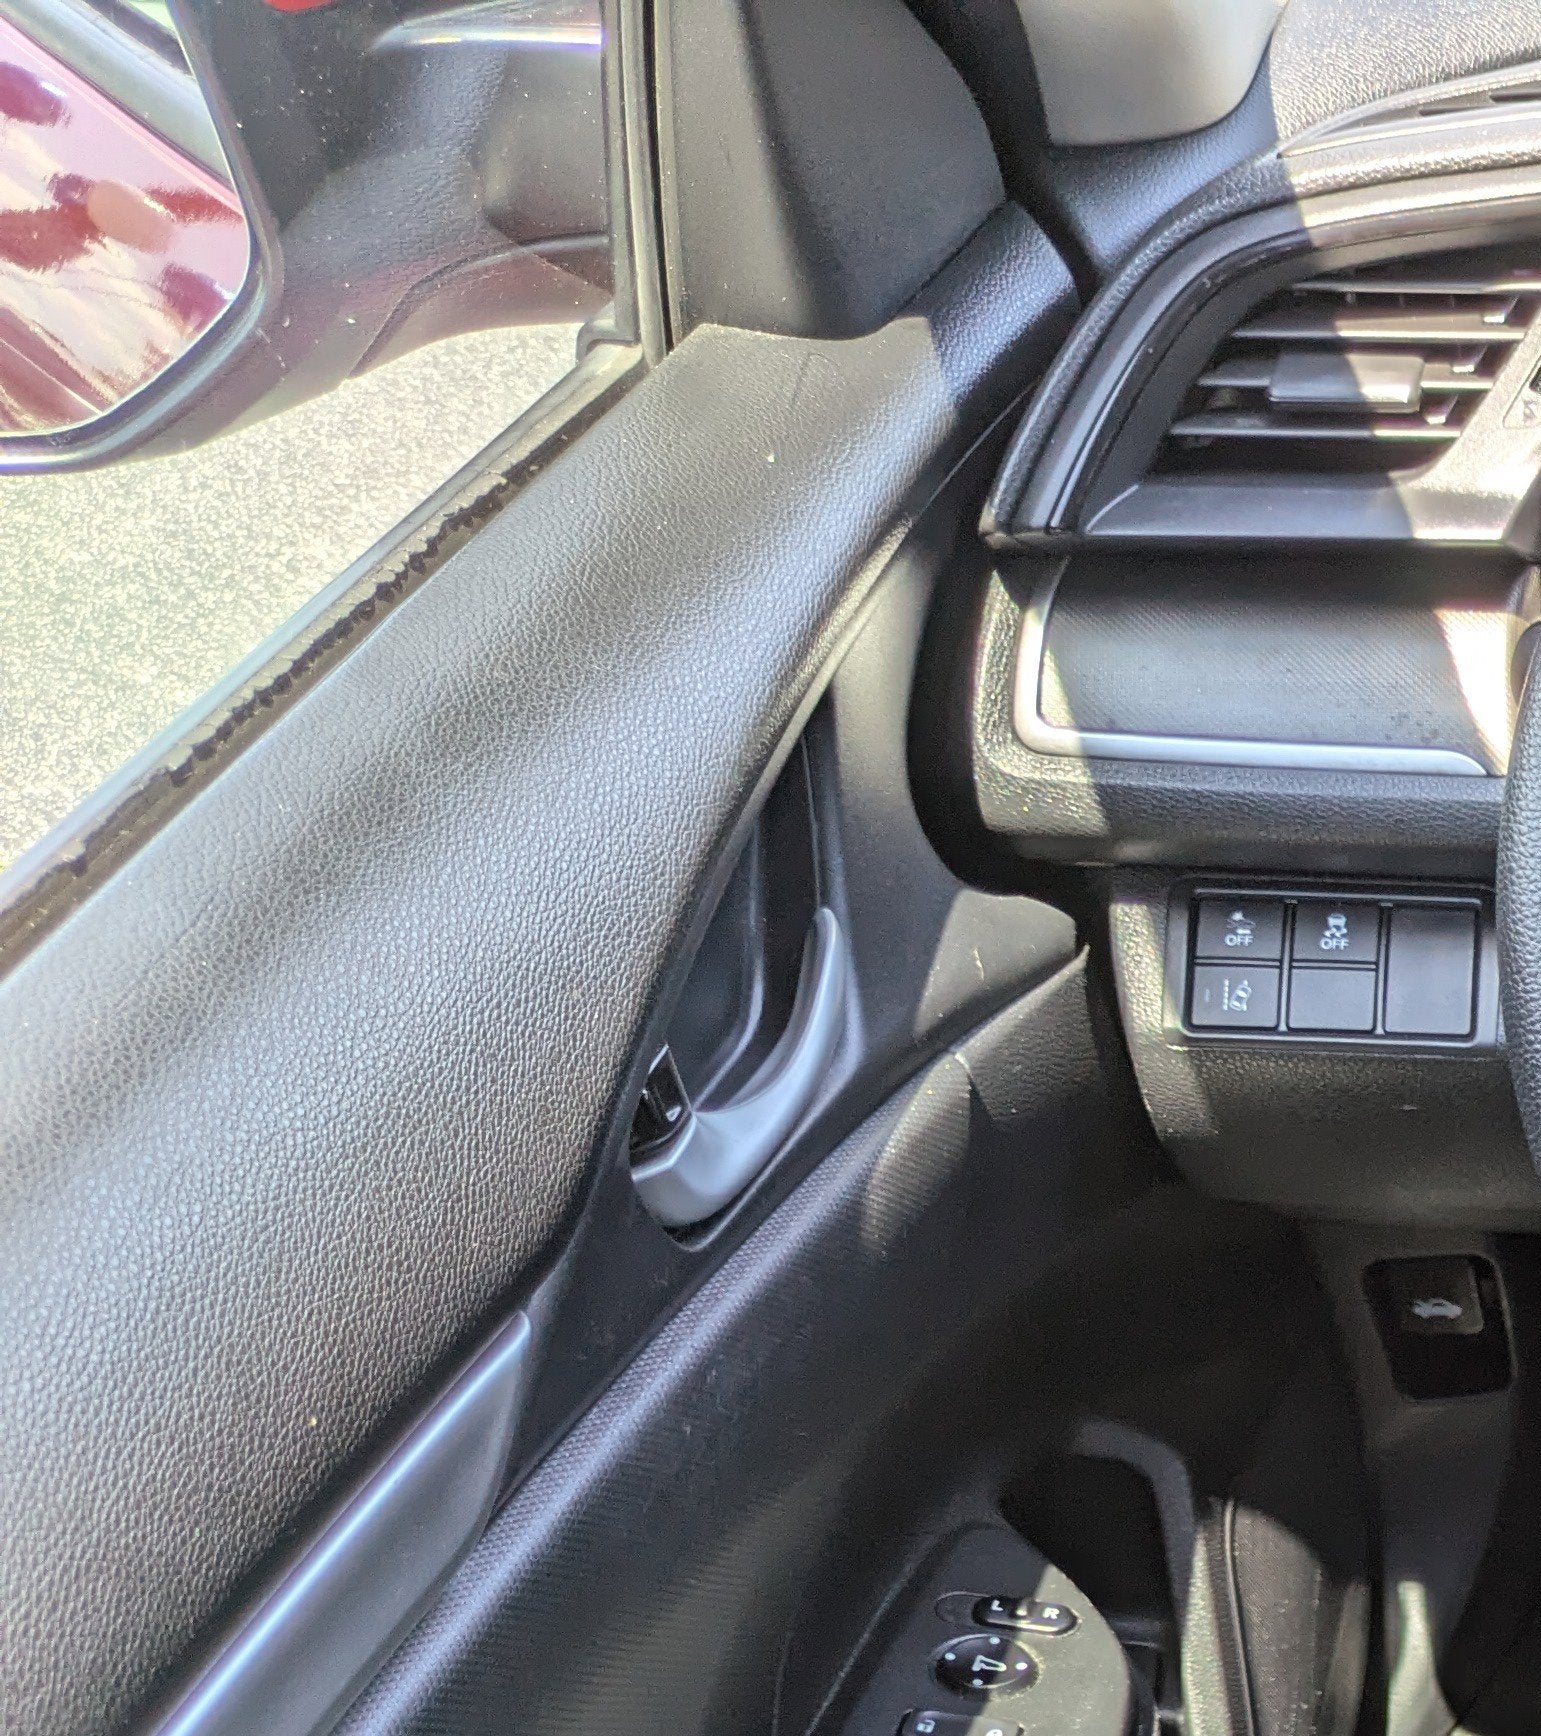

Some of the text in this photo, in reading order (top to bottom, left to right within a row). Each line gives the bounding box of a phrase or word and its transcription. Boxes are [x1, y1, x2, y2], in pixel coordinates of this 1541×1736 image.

[1224, 933, 1254, 947] OFF
[1319, 937, 1349, 950] OFF
[1043, 1606, 1060, 1620] R
